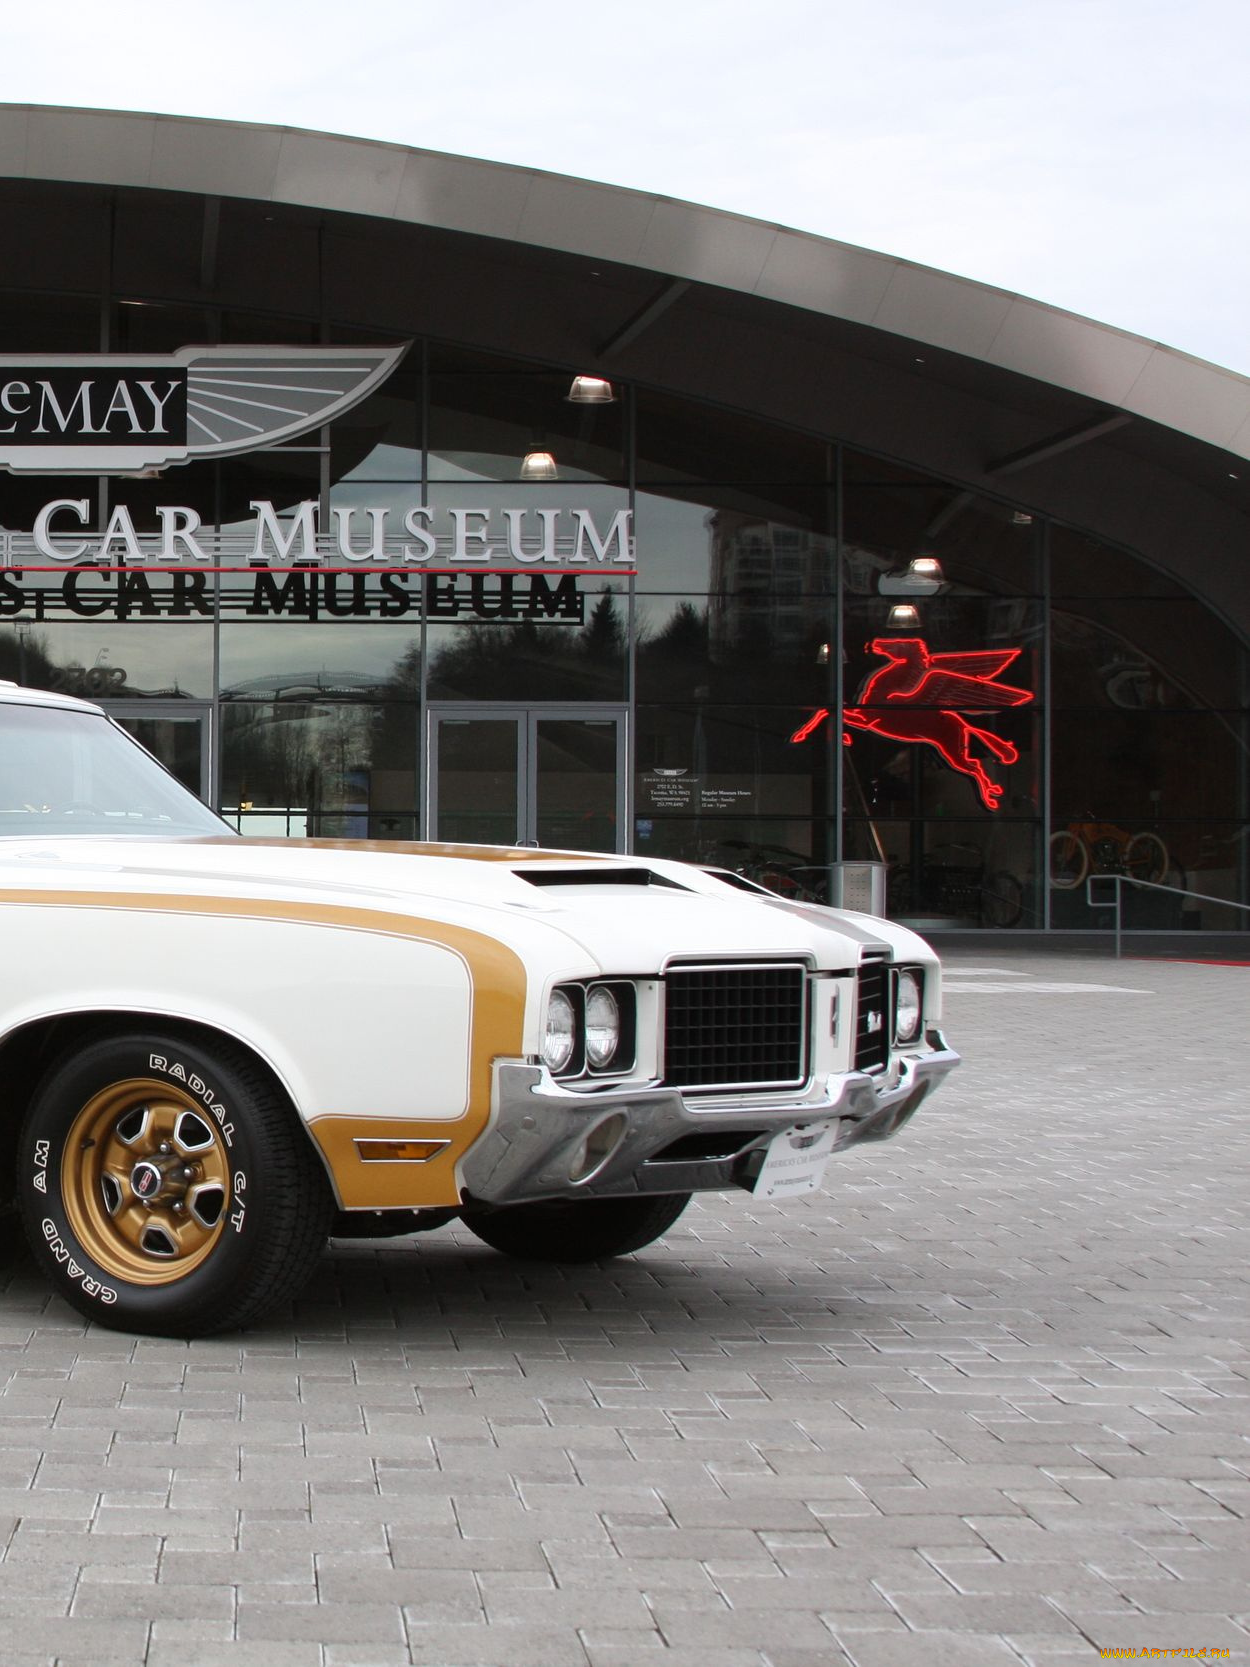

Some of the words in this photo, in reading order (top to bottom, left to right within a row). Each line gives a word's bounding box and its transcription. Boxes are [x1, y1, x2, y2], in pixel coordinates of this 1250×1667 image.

[33, 498, 209, 561] CAR
[250, 500, 635, 563] MUSEUM
[150, 1054, 239, 1147] RADIAL
[33, 1140, 50, 1194] AM
[42, 1218, 117, 1303] GRAND
